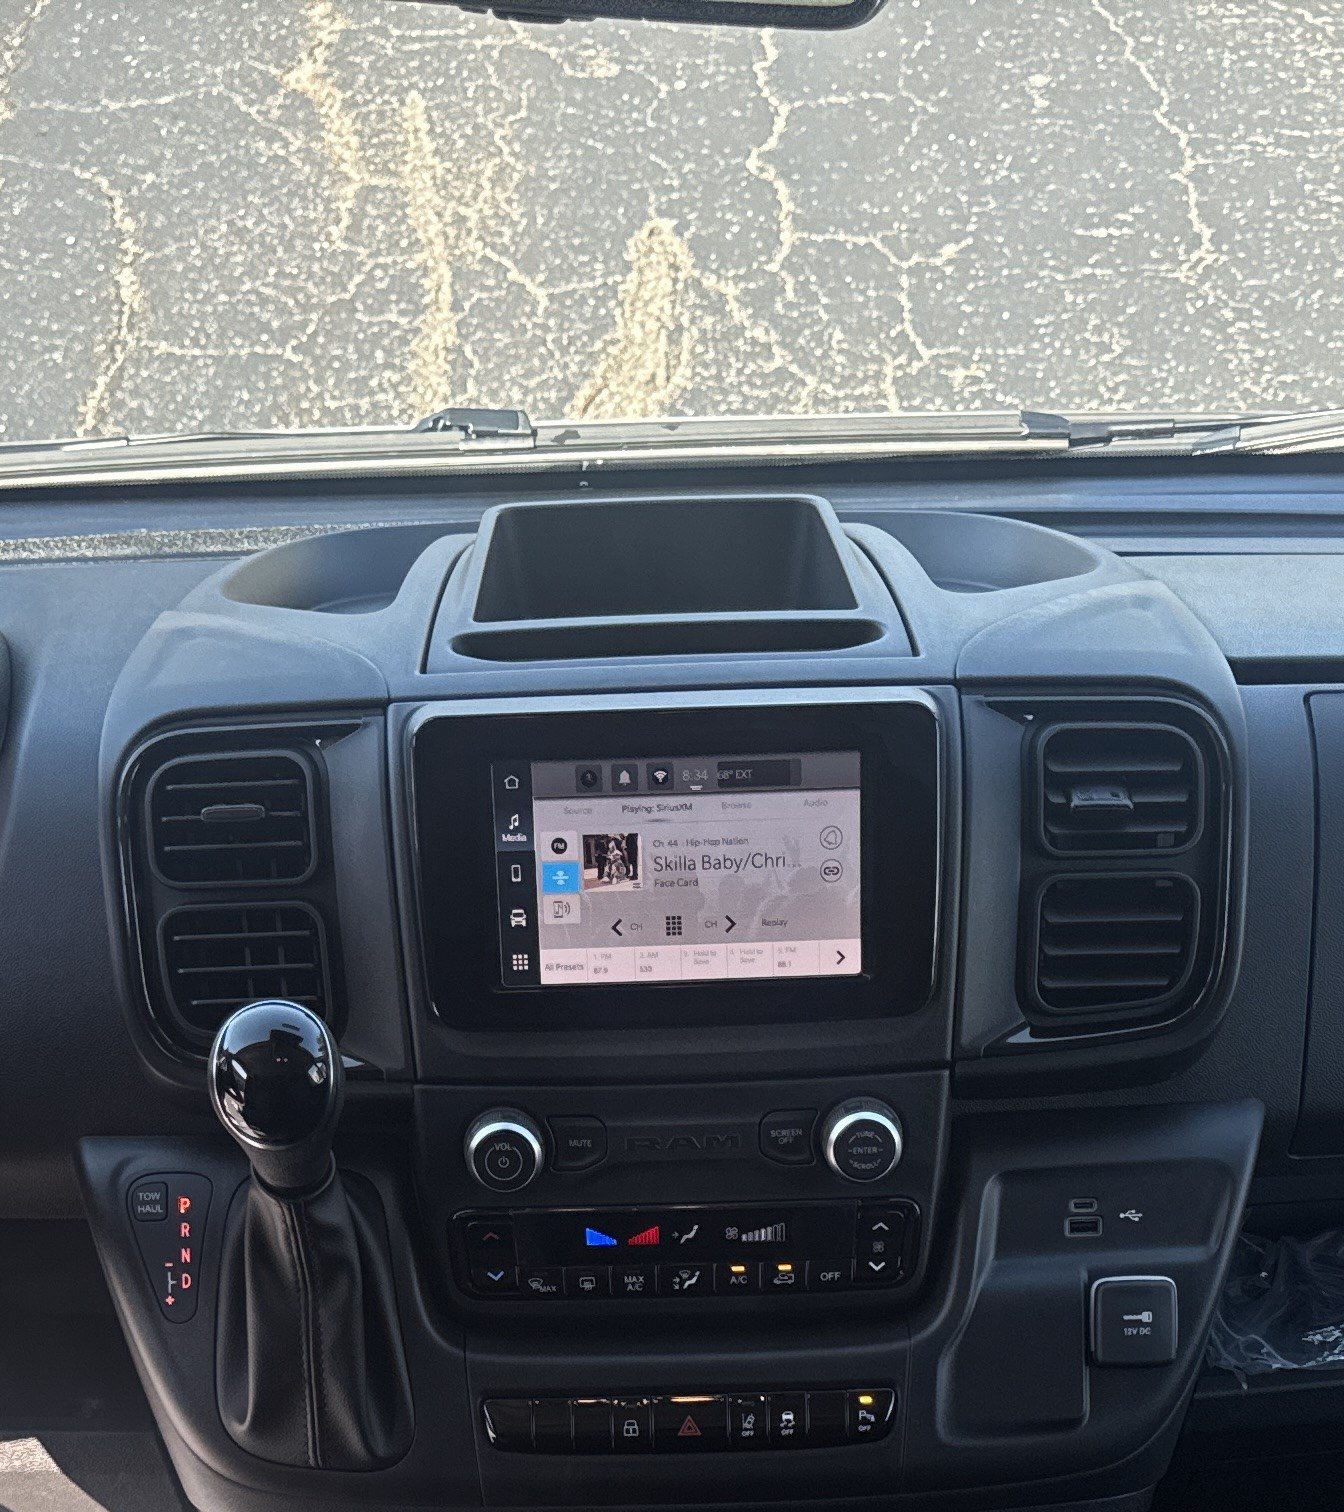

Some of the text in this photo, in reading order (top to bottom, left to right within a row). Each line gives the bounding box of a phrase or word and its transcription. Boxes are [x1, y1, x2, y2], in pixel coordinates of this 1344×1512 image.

[682, 769, 708, 782] 8:34
[735, 769, 753, 779] EXT
[656, 803, 693, 812] SiriusXM
[804, 798, 829, 808] Audio
[501, 833, 527, 842] Media
[652, 839, 665, 847] Ch
[721, 837, 749, 846] Nation
[654, 855, 697, 872] Skilla
[654, 878, 699, 888] Face Card
[761, 918, 788, 927] Replay
[556, 963, 584, 971] Presets
[770, 1128, 803, 1138] SCREEN
[568, 1139, 593, 1148] MUTE
[624, 1134, 742, 1152] RAM
[778, 1136, 795, 1145] OFF
[493, 1142, 512, 1151] VOL
[852, 1146, 878, 1155] ENTER
[137, 1191, 161, 1201] TOW
[137, 1204, 163, 1214] HAUL
[178, 1197, 191, 1214] P
[180, 1222, 191, 1238] R
[180, 1247, 191, 1264] N
[181, 1272, 192, 1289] D
[730, 1275, 748, 1285] A/C
[820, 1271, 841, 1282] OFF
[626, 1283, 643, 1292] A/C
[1123, 1326, 1152, 1336] 12V DC
[781, 1428, 794, 1436] OFF
[858, 1424, 871, 1432] OFF
